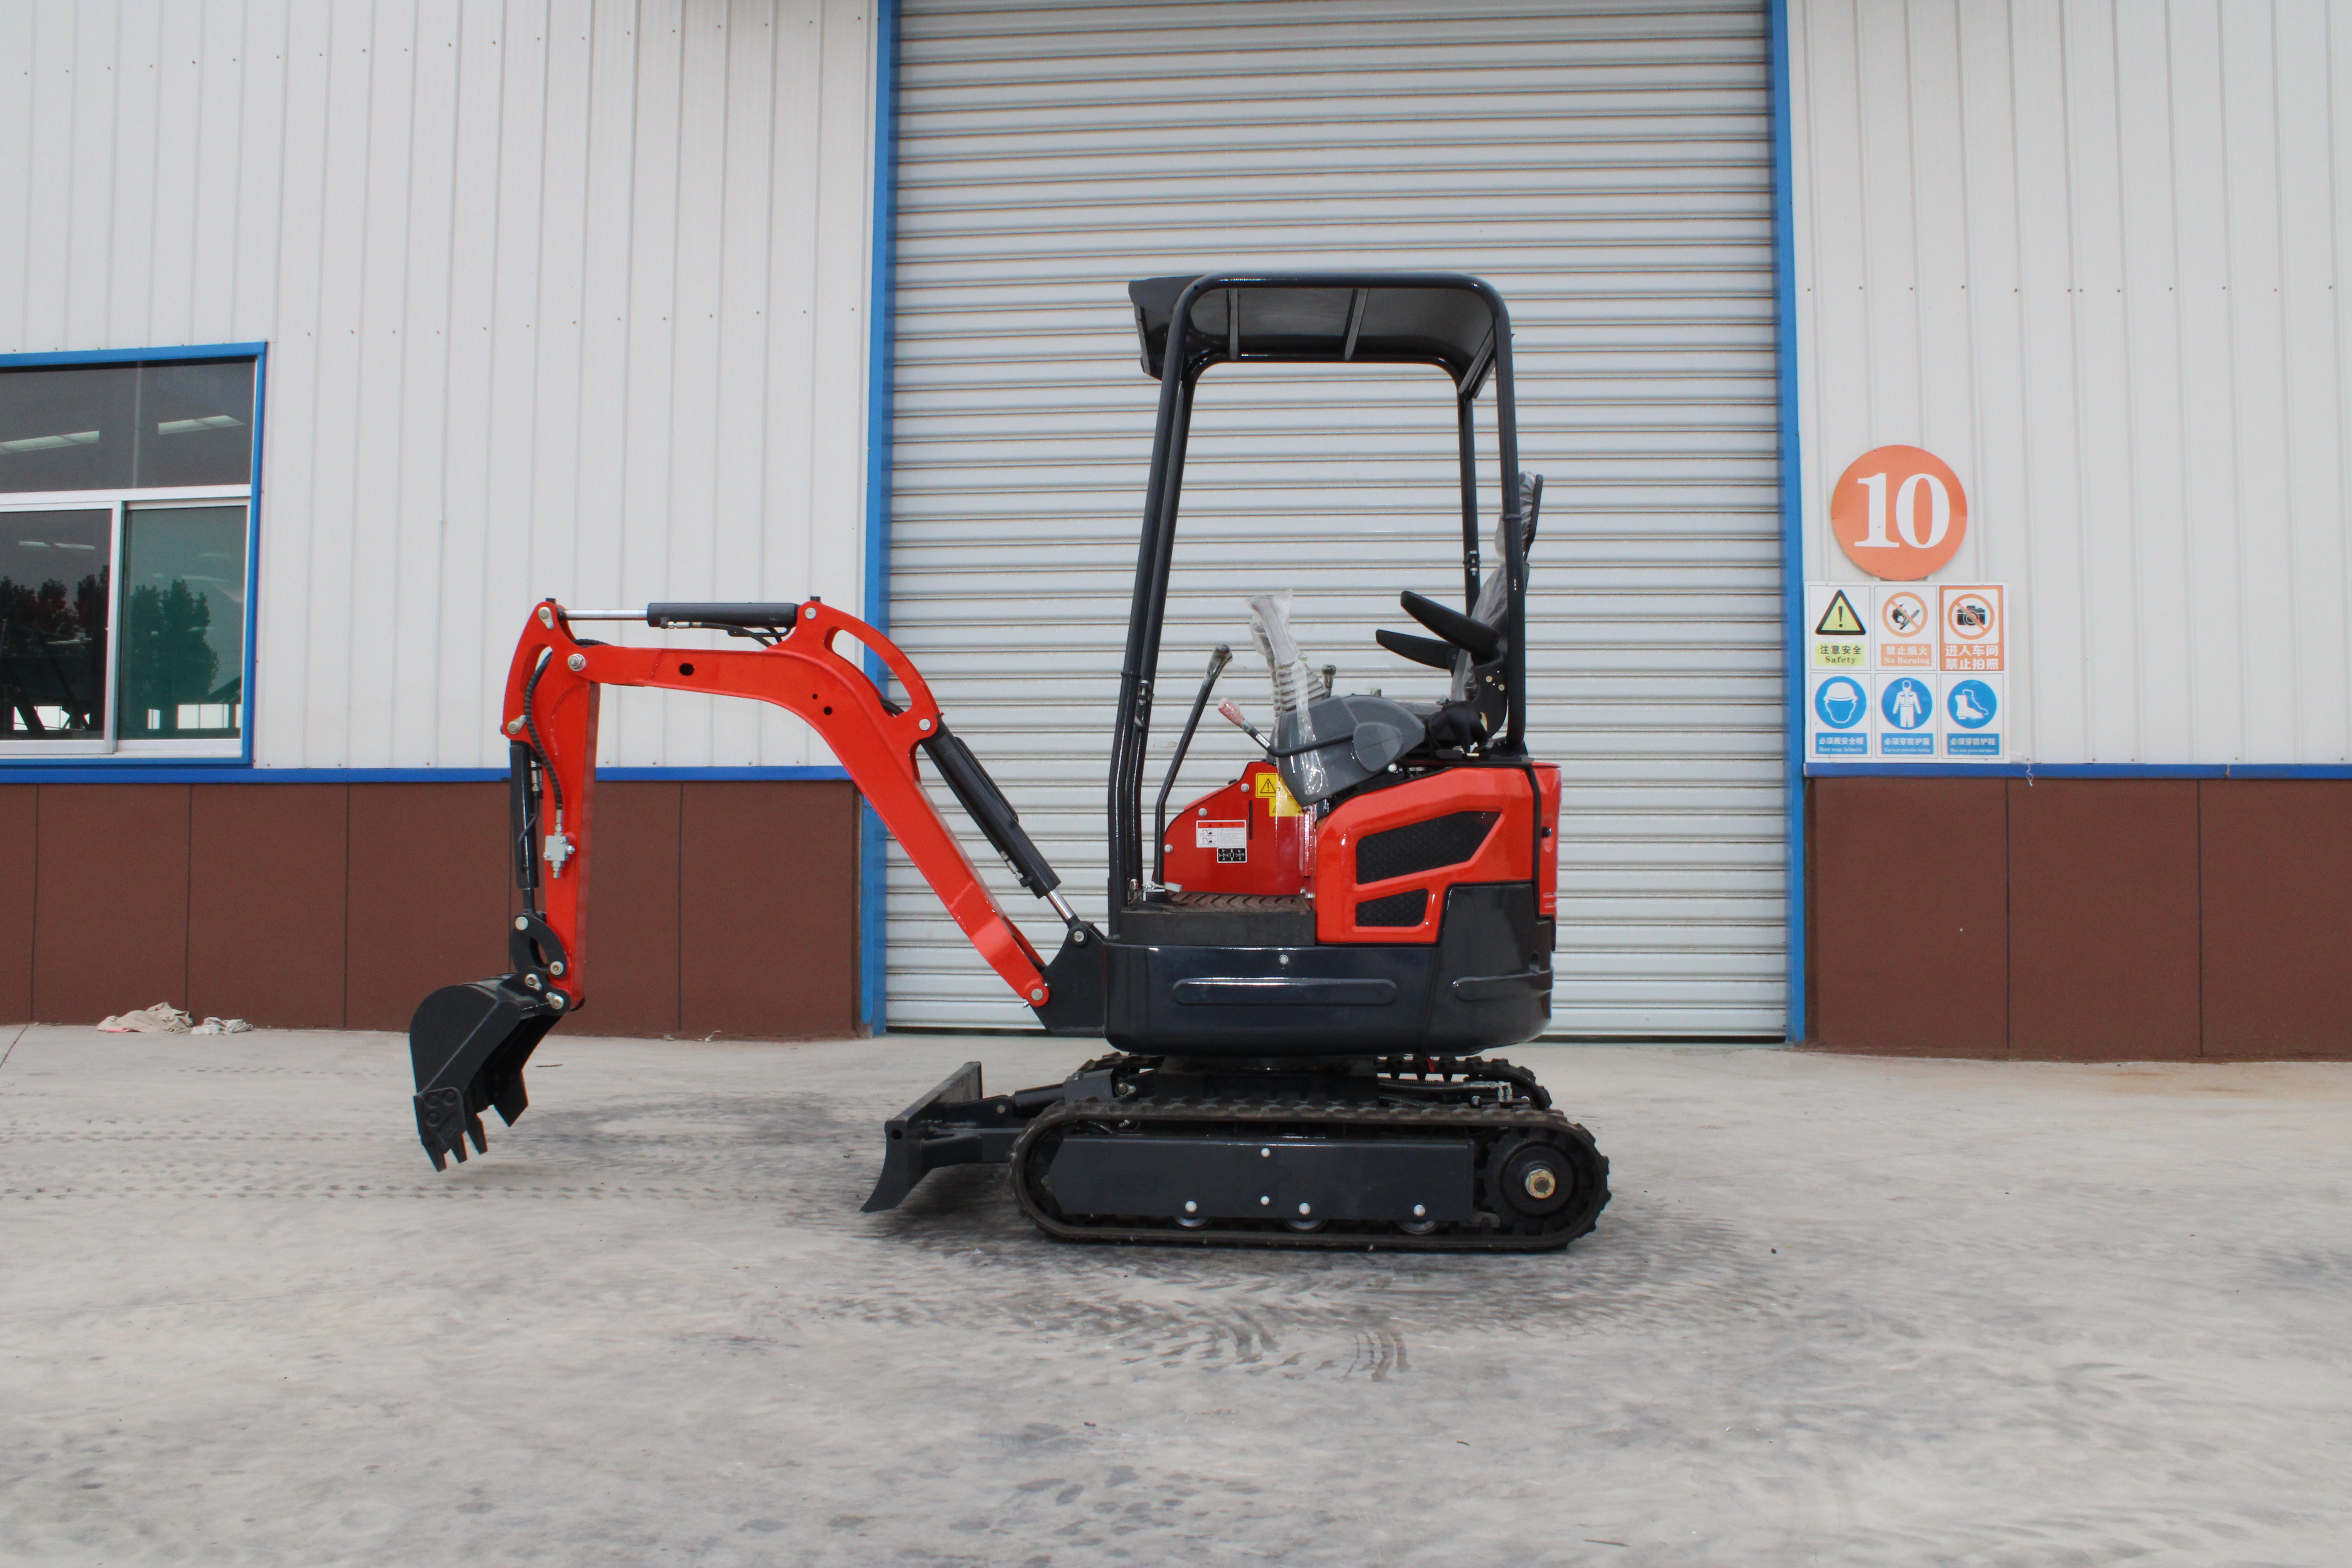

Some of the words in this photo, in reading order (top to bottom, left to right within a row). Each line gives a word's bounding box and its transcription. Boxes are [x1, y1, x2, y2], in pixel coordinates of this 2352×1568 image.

[1854, 472, 1950, 549] 10
[1820, 645, 1861, 655] 注意安全
[1886, 646, 1927, 655] 禁止烟火
[1945, 645, 1998, 657] 进入车间
[1945, 659, 1998, 670] 禁止拍照
